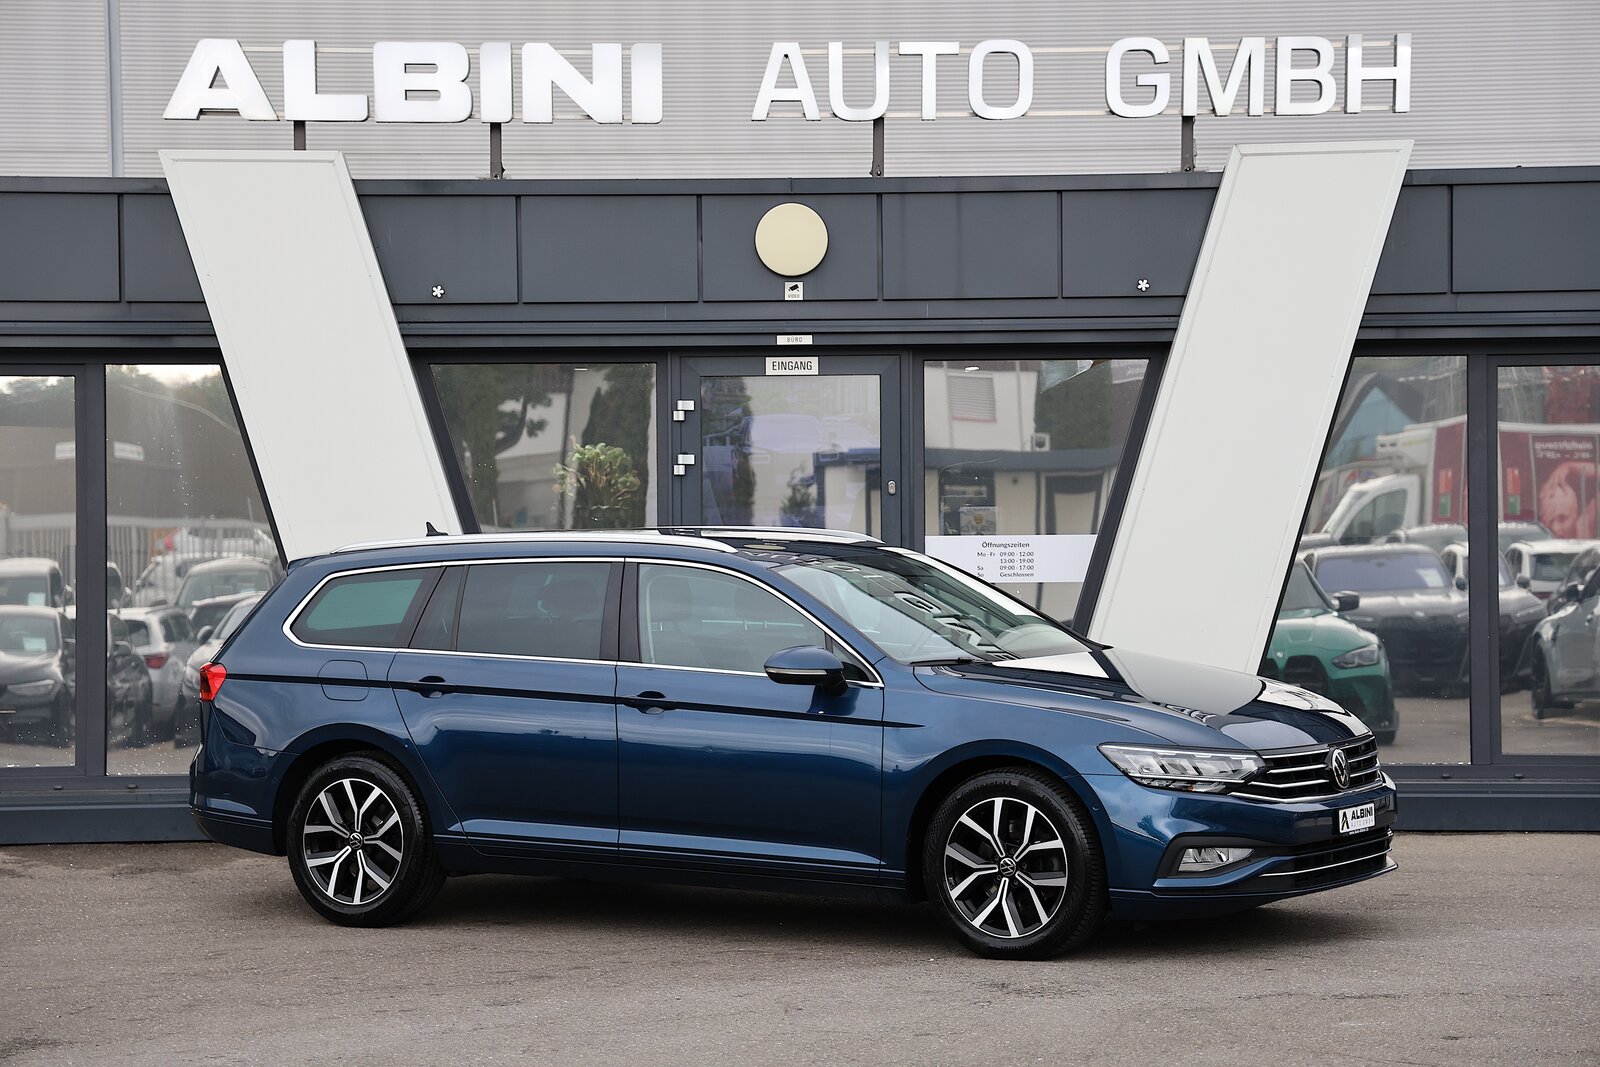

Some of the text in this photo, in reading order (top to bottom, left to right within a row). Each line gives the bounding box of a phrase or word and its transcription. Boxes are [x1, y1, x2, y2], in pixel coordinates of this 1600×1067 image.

[163, 32, 1412, 124] ALBINI AUTO GMBH
[772, 360, 813, 371] EINGANG
[1351, 806, 1373, 820] ALBINI
